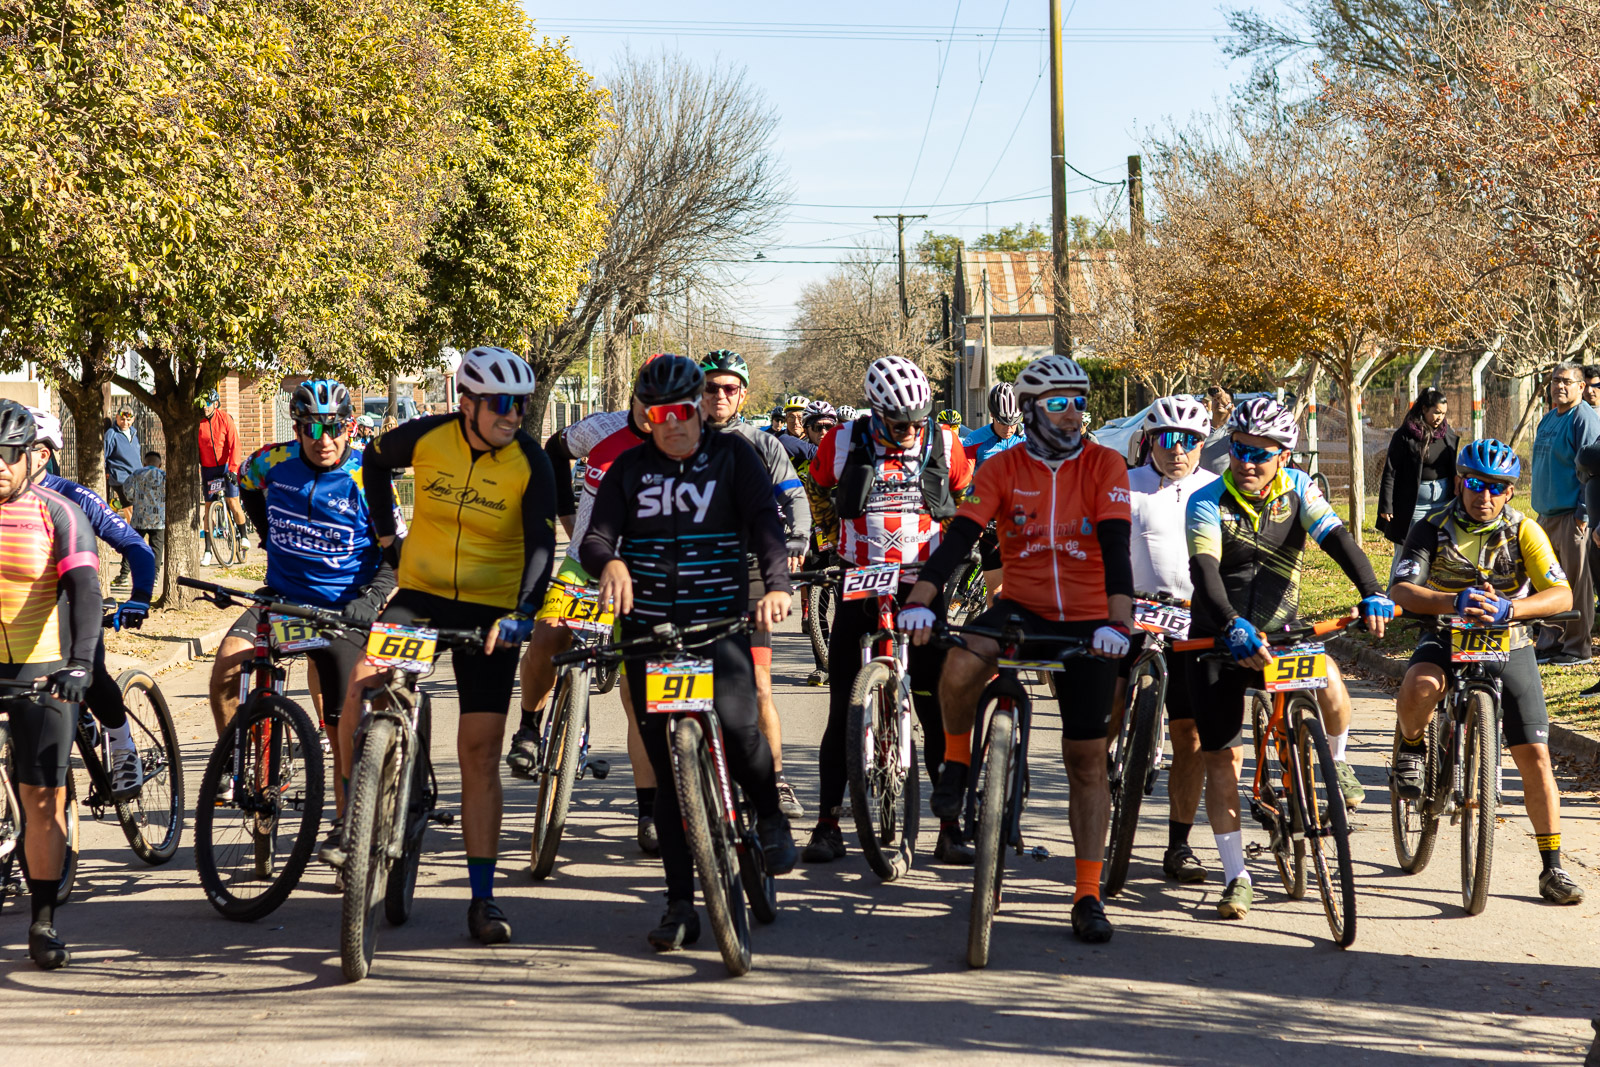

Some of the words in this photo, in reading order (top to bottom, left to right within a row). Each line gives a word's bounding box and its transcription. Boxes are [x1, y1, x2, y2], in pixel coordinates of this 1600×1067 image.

[324, 527, 341, 540] de
[847, 571, 895, 591] 209
[1140, 608, 1186, 631] 216
[379, 636, 424, 660] 68
[1277, 655, 1315, 680] 58
[662, 675, 696, 699] 91
